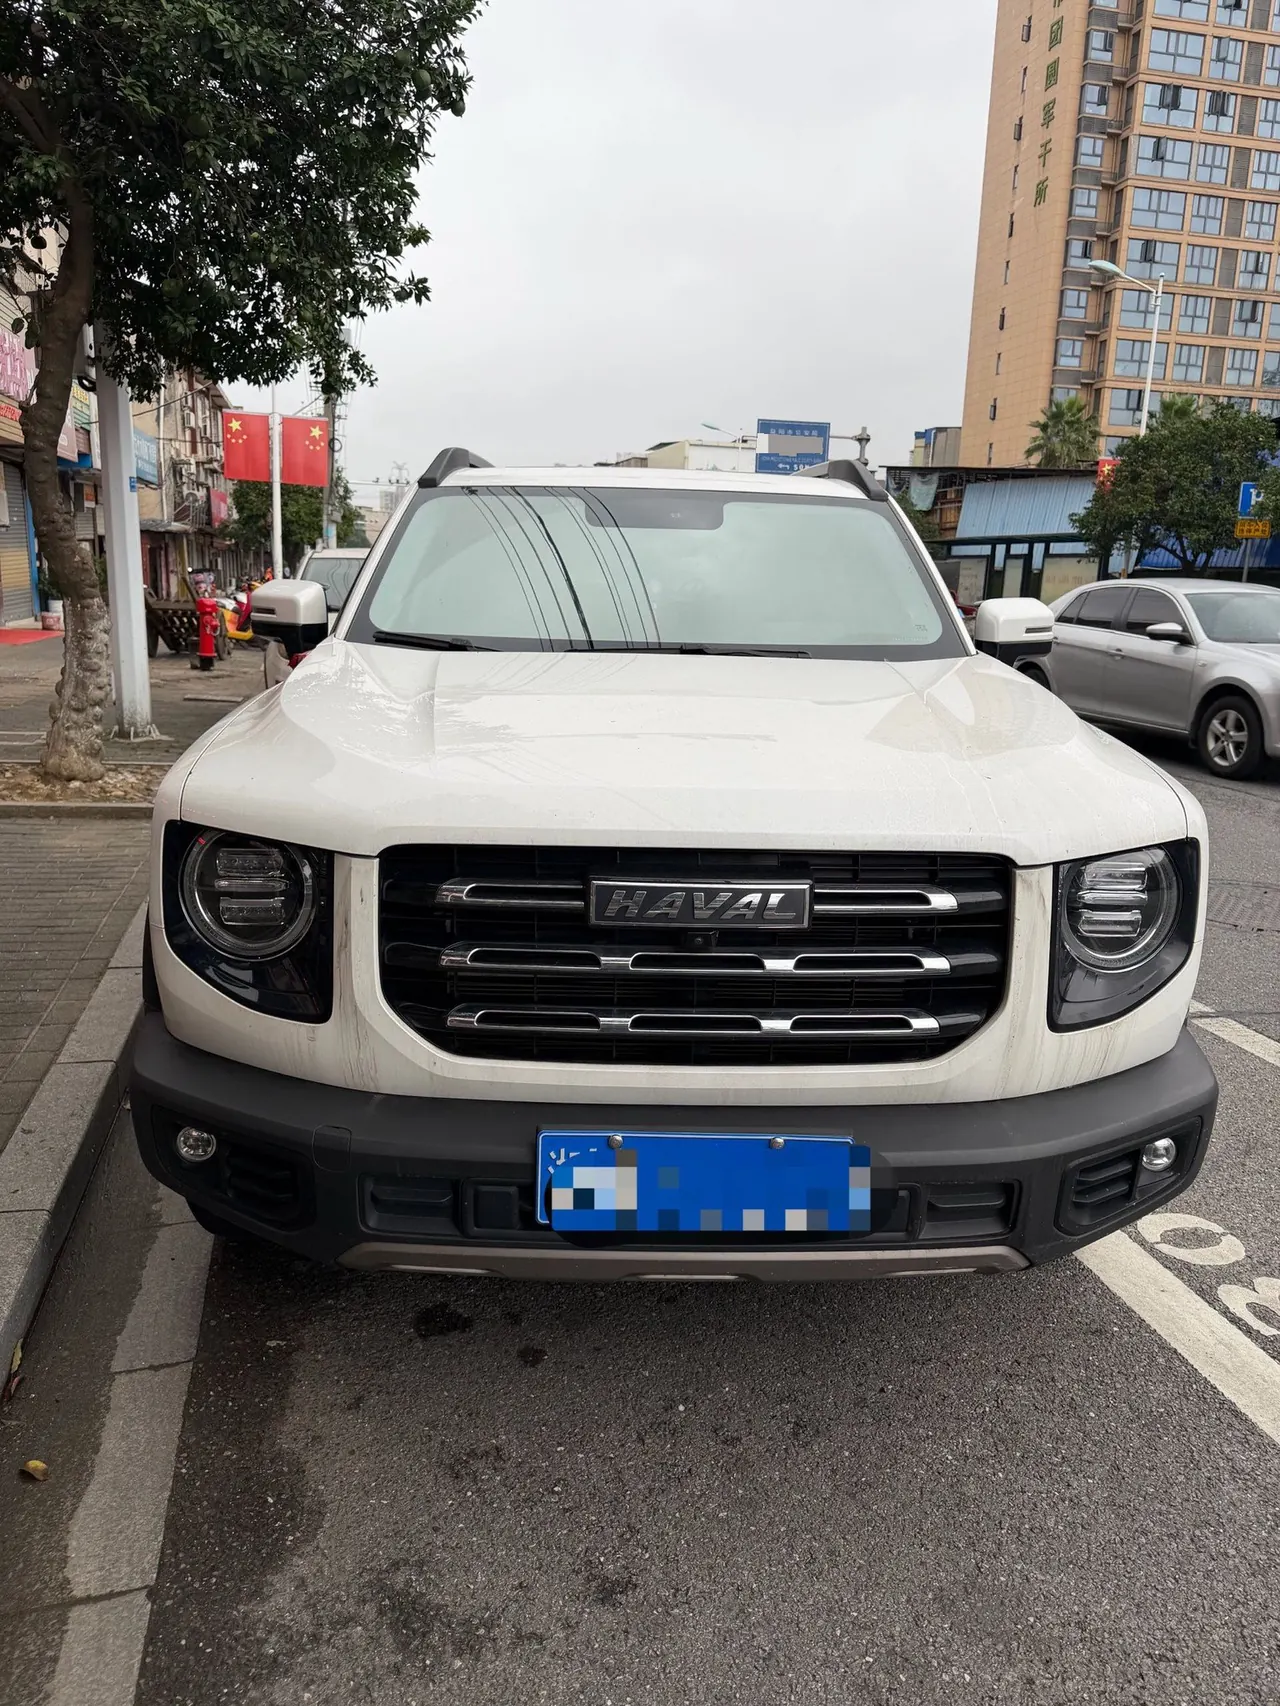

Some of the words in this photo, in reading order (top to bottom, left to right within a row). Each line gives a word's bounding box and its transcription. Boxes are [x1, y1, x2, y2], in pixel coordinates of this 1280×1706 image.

[1033, 0, 1064, 207] 团圆军干所
[603, 890, 797, 920] HAVAL
